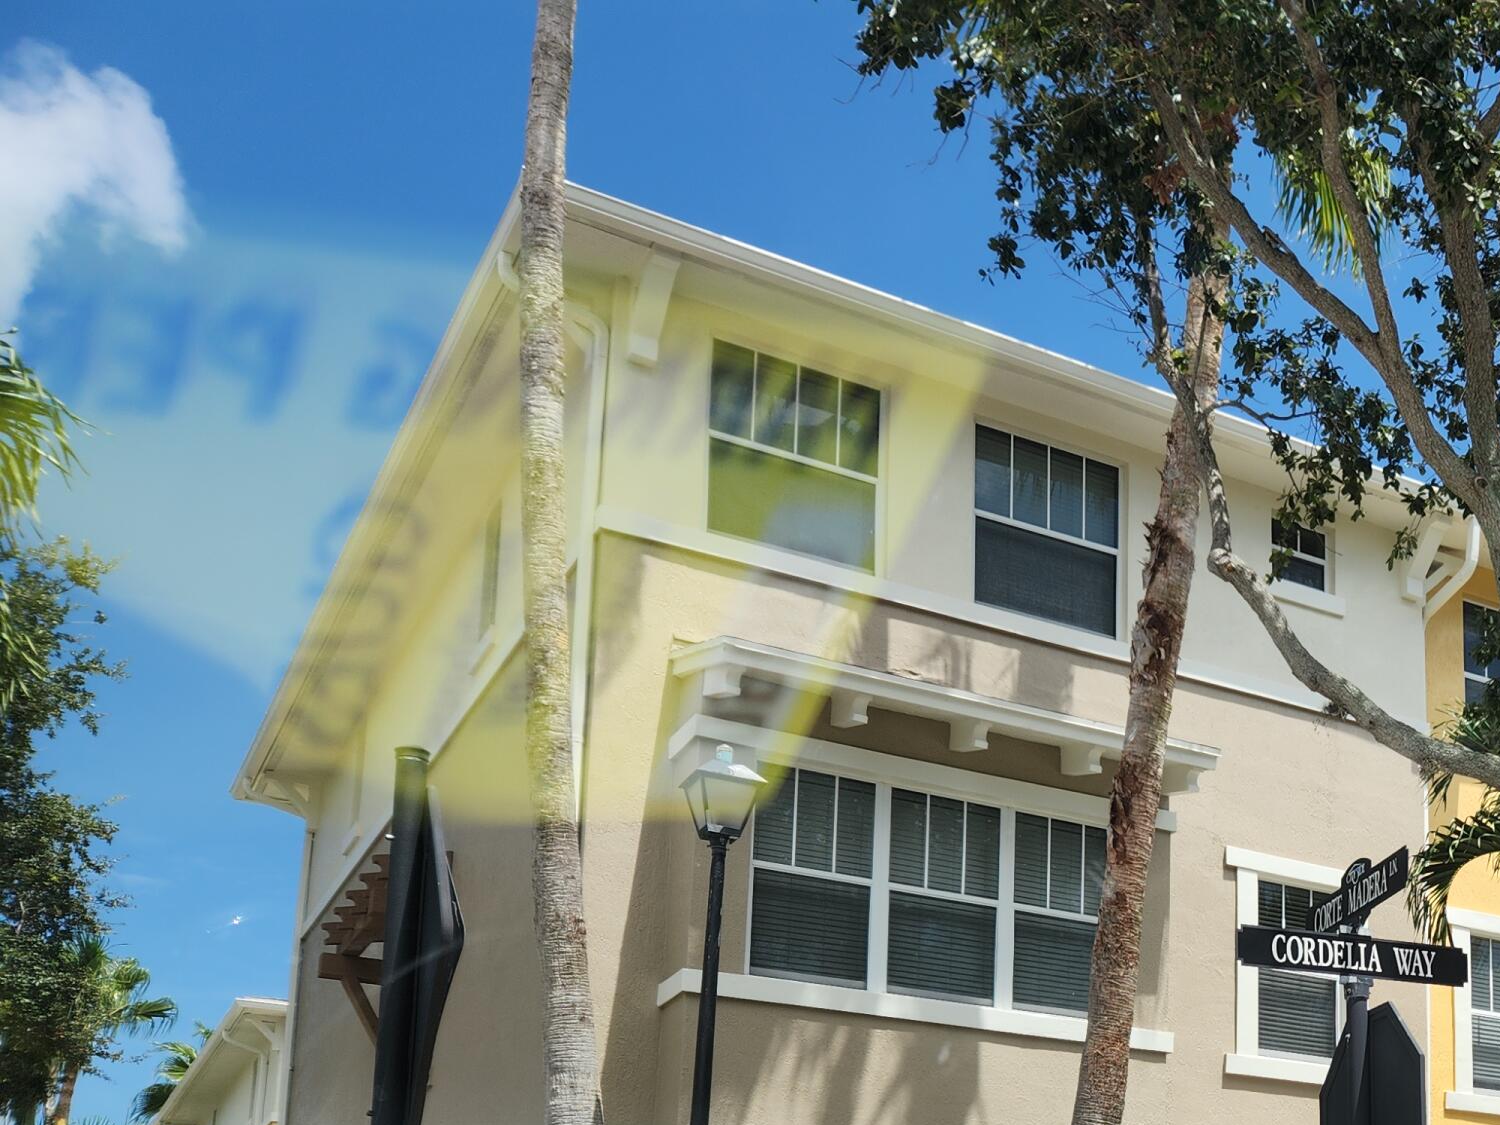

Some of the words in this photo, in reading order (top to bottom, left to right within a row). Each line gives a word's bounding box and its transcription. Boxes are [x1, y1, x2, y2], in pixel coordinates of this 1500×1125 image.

[1314, 894, 1343, 932] CORTE
[1347, 864, 1388, 915] MADERA
[1389, 857, 1398, 877] LN
[1271, 933, 1382, 973] CORDELIA
[1393, 946, 1436, 978] WAY
